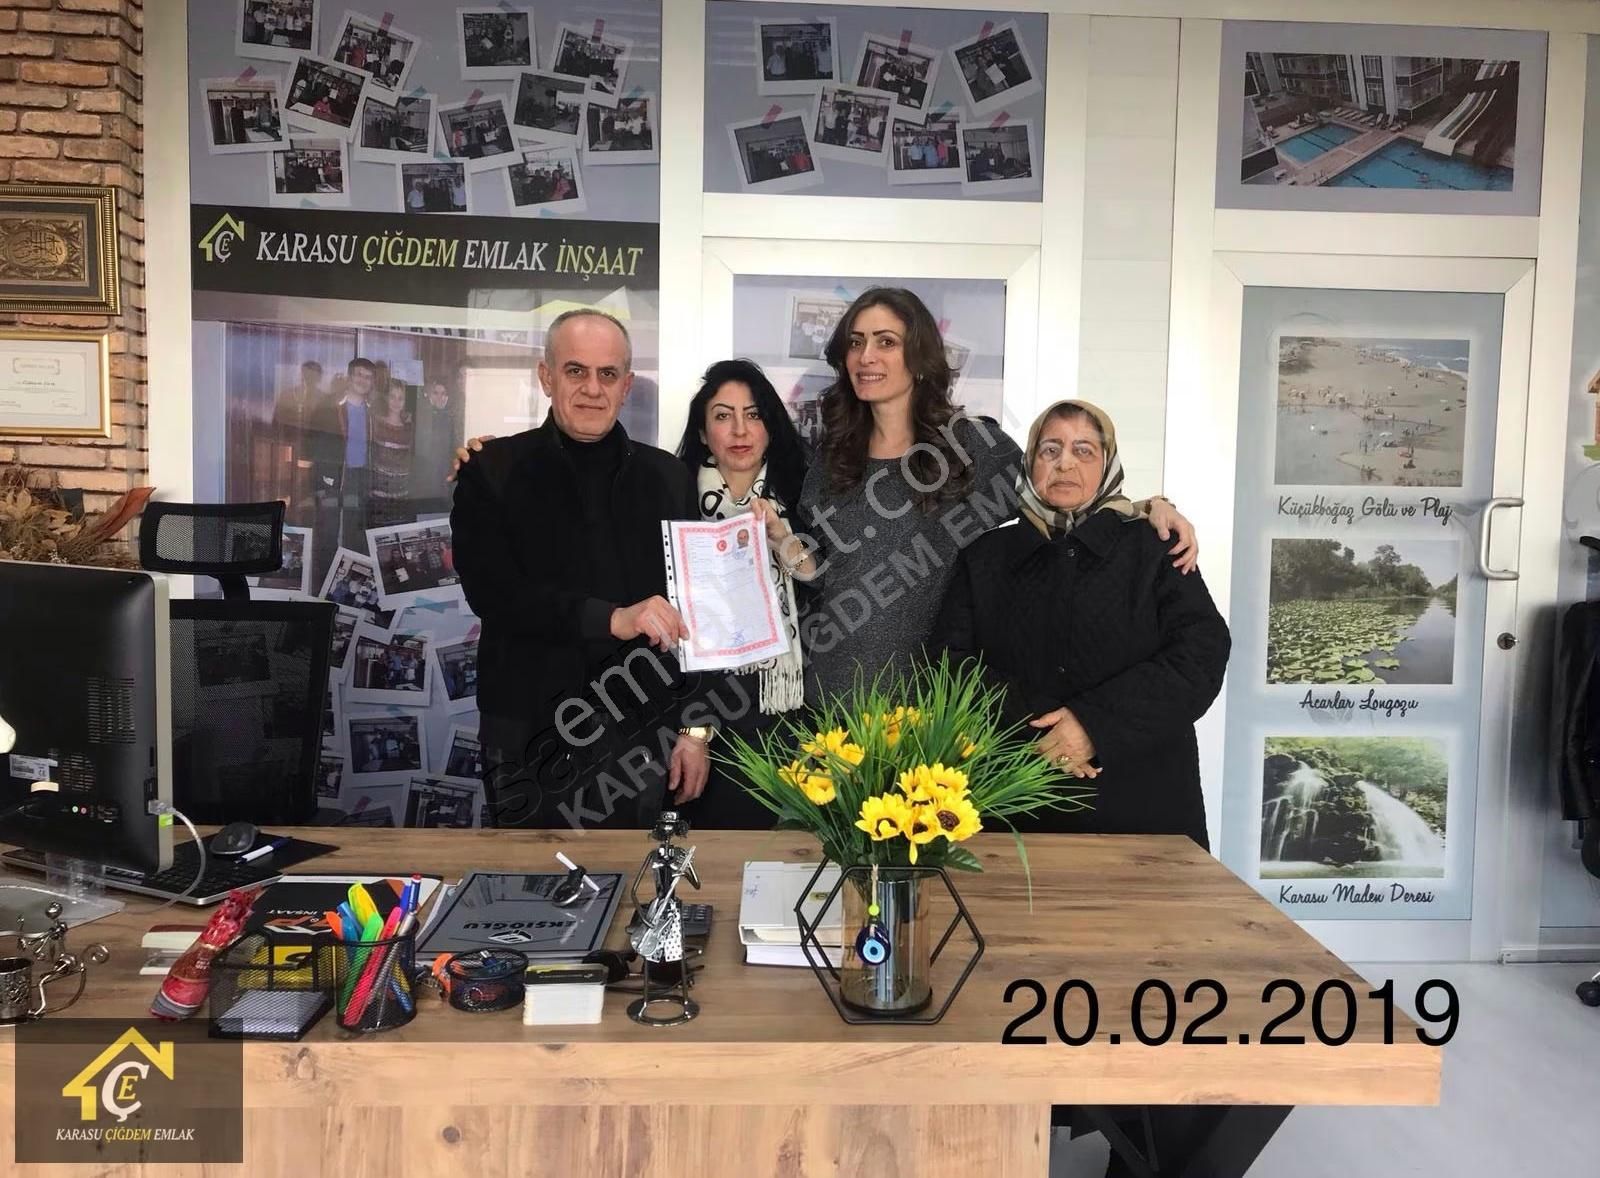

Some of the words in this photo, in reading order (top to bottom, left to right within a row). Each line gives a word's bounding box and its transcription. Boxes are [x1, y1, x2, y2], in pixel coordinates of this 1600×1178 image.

[256, 231, 358, 264] KARASU
[362, 230, 459, 271] ÇİĞDEM
[462, 239, 549, 271] EMLAK
[555, 238, 643, 281] İNŞAAT
[1277, 494, 1355, 525] Küçükboğaz
[1361, 496, 1398, 517] Gölü
[1401, 507, 1416, 517] ve
[1299, 689, 1355, 709] Acarlar
[1359, 688, 1419, 718] Longozu
[1279, 884, 1328, 904] Karasu
[1332, 883, 1384, 903] Maden
[1390, 883, 1434, 903] Deresi
